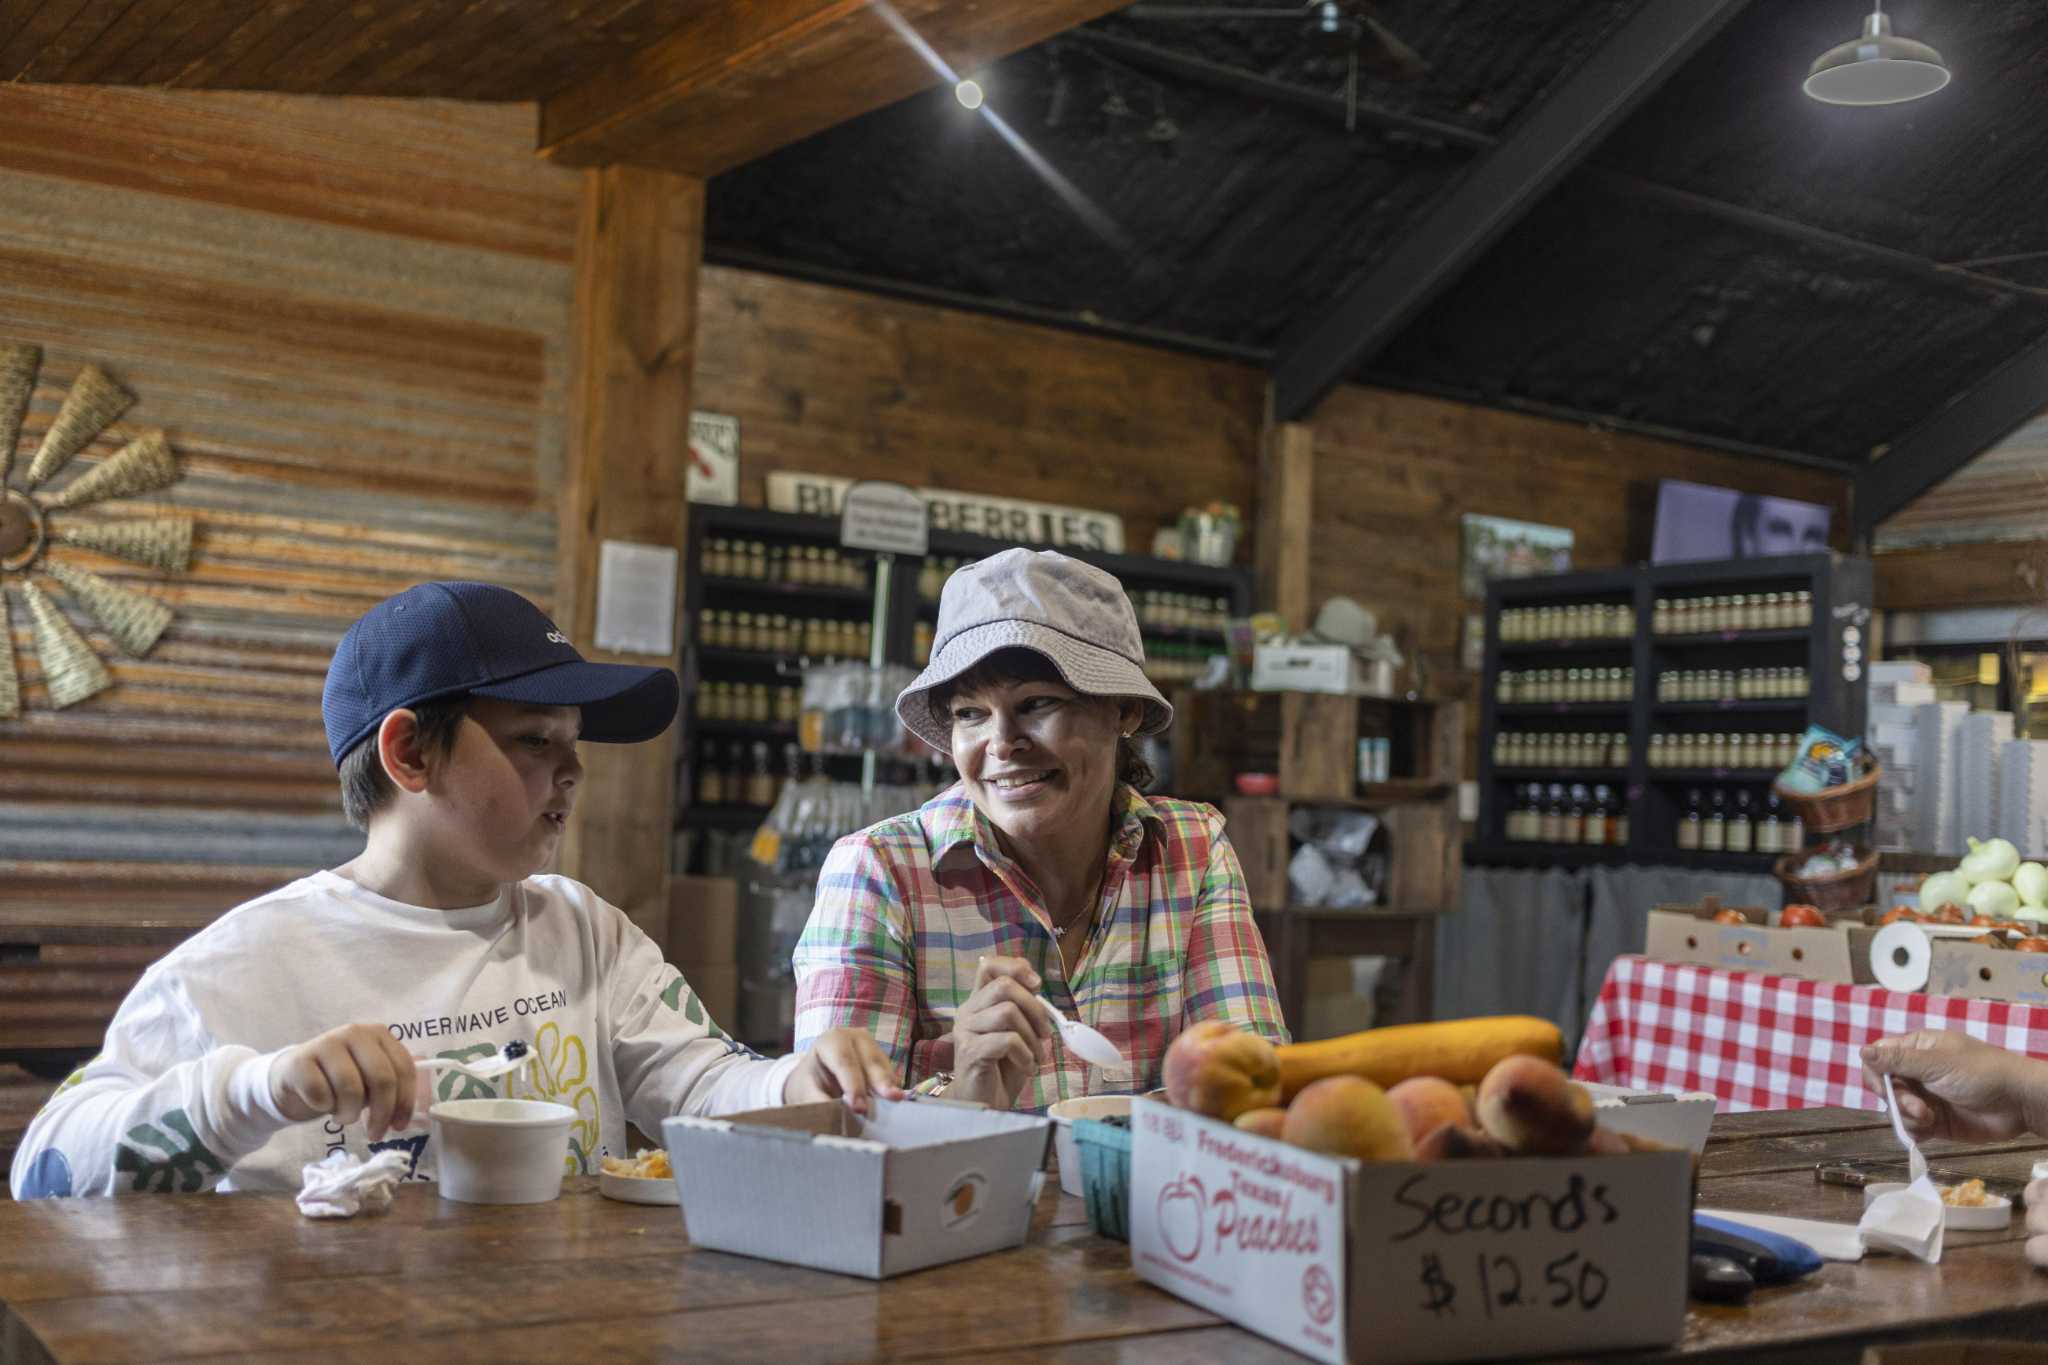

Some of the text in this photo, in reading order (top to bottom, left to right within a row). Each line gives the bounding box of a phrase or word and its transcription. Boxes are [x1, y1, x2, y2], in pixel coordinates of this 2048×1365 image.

[797, 483, 1106, 549] BLBERRIES
[514, 990, 567, 1017] OCEAN
[1212, 1187, 1319, 1256] Peaches
